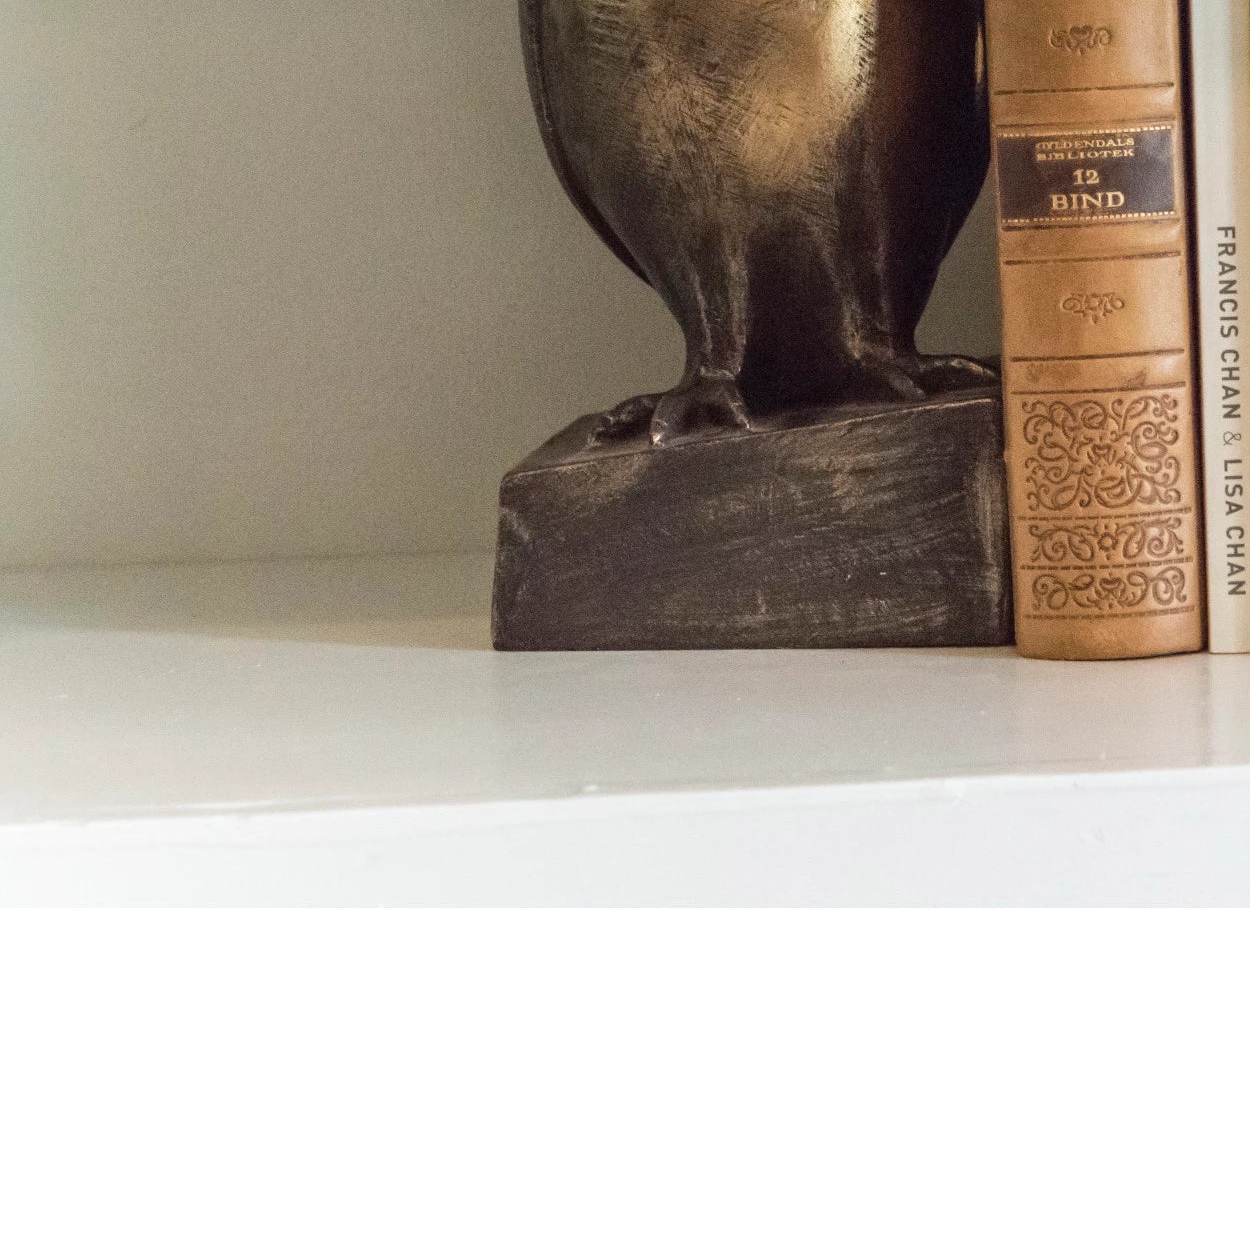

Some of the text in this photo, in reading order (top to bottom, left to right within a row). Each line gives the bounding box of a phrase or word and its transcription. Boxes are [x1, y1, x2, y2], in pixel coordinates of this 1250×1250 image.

[1035, 136, 1135, 150] GYLDENDALS
[1036, 148, 1135, 161] BIBLIOTEK
[1073, 169, 1100, 185] 12
[1051, 191, 1125, 210] BIND
[1217, 226, 1246, 596] FRANCIS CHAN & LISA CHAN
